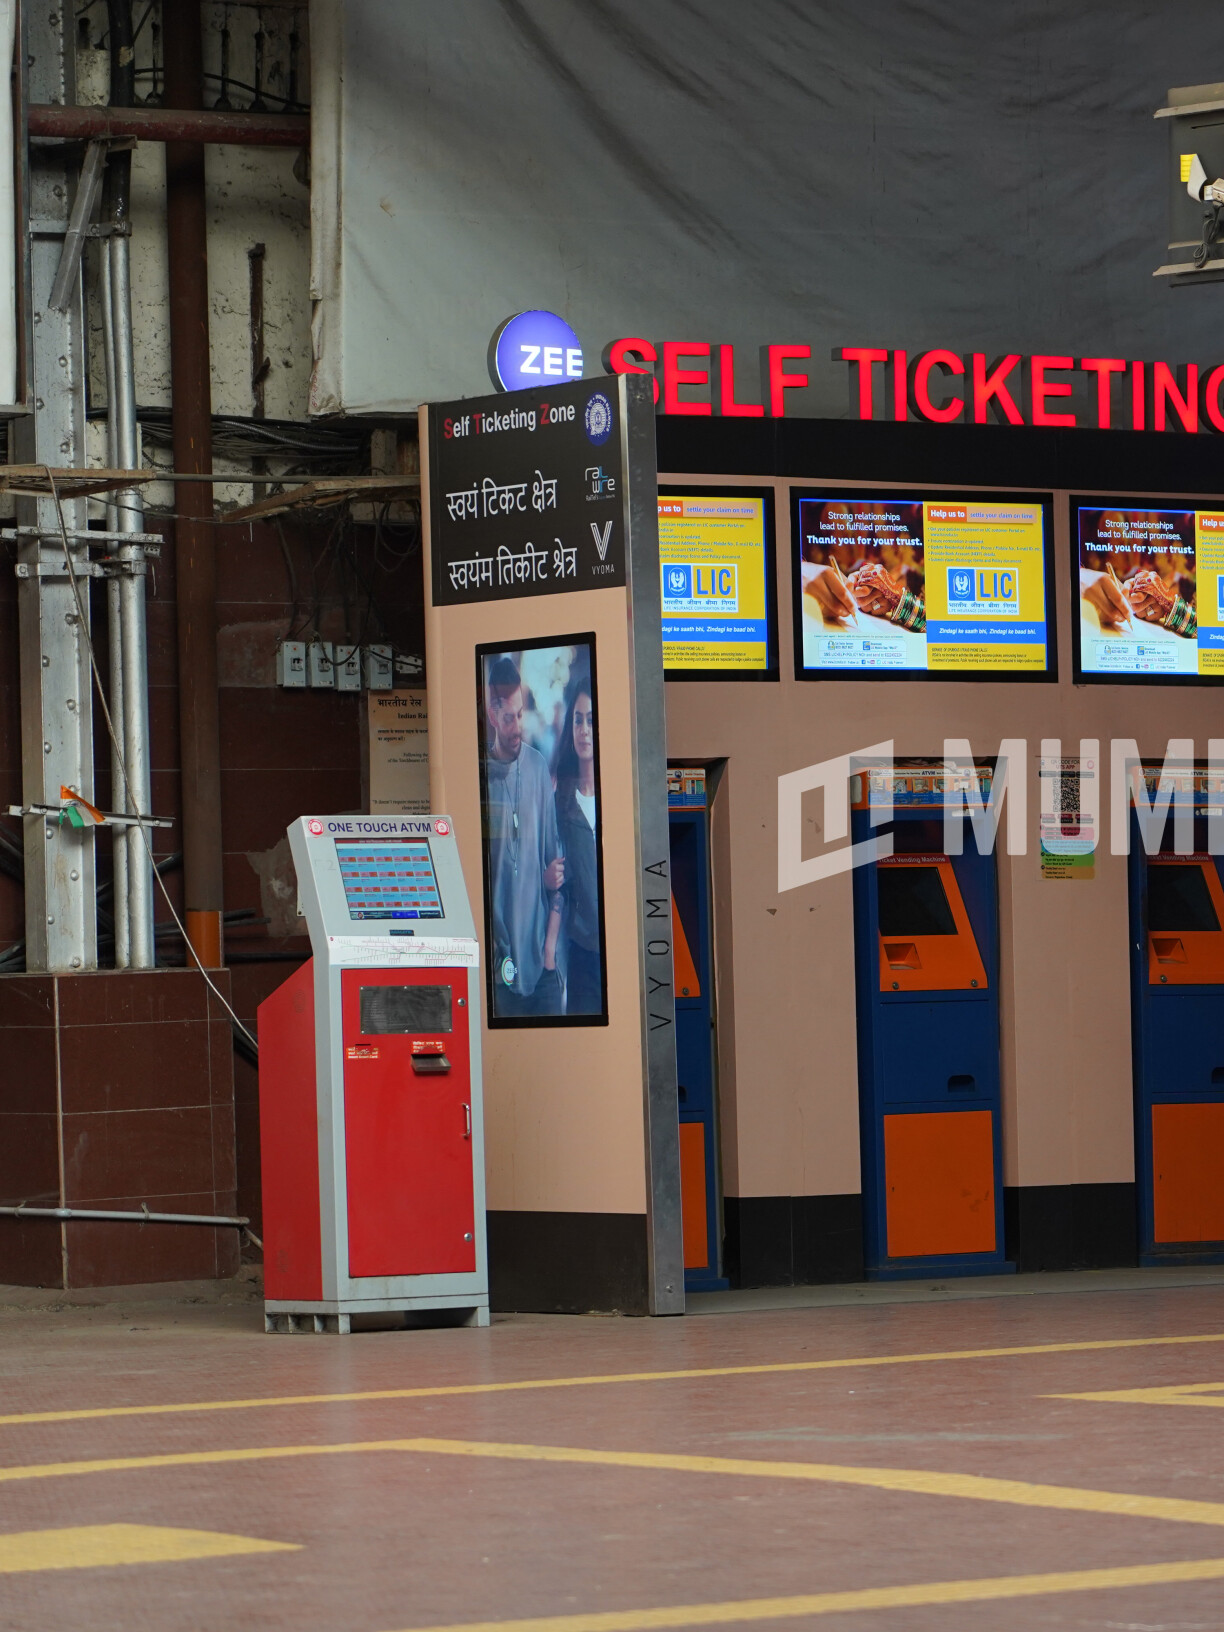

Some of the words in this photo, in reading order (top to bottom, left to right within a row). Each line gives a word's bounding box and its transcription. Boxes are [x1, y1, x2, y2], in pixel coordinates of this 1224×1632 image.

[519, 344, 584, 378] ZEE
[608, 337, 812, 418] SELF
[444, 414, 470, 439] Self
[473, 408, 536, 435] Ticketing
[540, 403, 576, 425] Zone
[446, 482, 478, 521] स्वयं
[481, 477, 527, 517] टिकट
[532, 470, 557, 513] क्षेत्र
[828, 511, 853, 522] Strong
[855, 512, 900, 522] relationships
[930, 509, 947, 519] Help
[957, 510, 965, 518] to
[820, 522, 835, 530] lead
[846, 522, 873, 531] fulfilled
[875, 523, 909, 533] promises.
[1105, 519, 1129, 530] Strong
[1130, 521, 1174, 531] relationships
[1202, 518, 1218, 528] Help
[807, 535, 836, 545] Thank
[838, 537, 855, 546] you
[857, 535, 871, 545] for
[873, 537, 895, 547] your
[896, 536, 923, 546] trust.
[1097, 529, 1112, 538] lead
[1113, 530, 1121, 538] to
[1122, 530, 1148, 539] fulfilled
[1149, 532, 1182, 541] promises.
[1085, 542, 1113, 552] Thank
[1115, 545, 1131, 554] you
[1133, 544, 1146, 553] for
[1148, 546, 1168, 555] your
[1169, 545, 1195, 554] trust.
[448, 551, 493, 590] स्वयंम
[496, 542, 548, 585] तिकीट
[592, 564, 615, 575] VYOMA
[696, 569, 731, 595] LIC
[980, 572, 1012, 598] LIC
[377, 696, 407, 707] भारतीय
[408, 696, 422, 707] रेल
[398, 712, 417, 720] Indian
[328, 822, 353, 833] ONE
[356, 822, 397, 833] TOUCH
[400, 822, 432, 833] ATVM
[645, 859, 673, 1031] VYOMA
